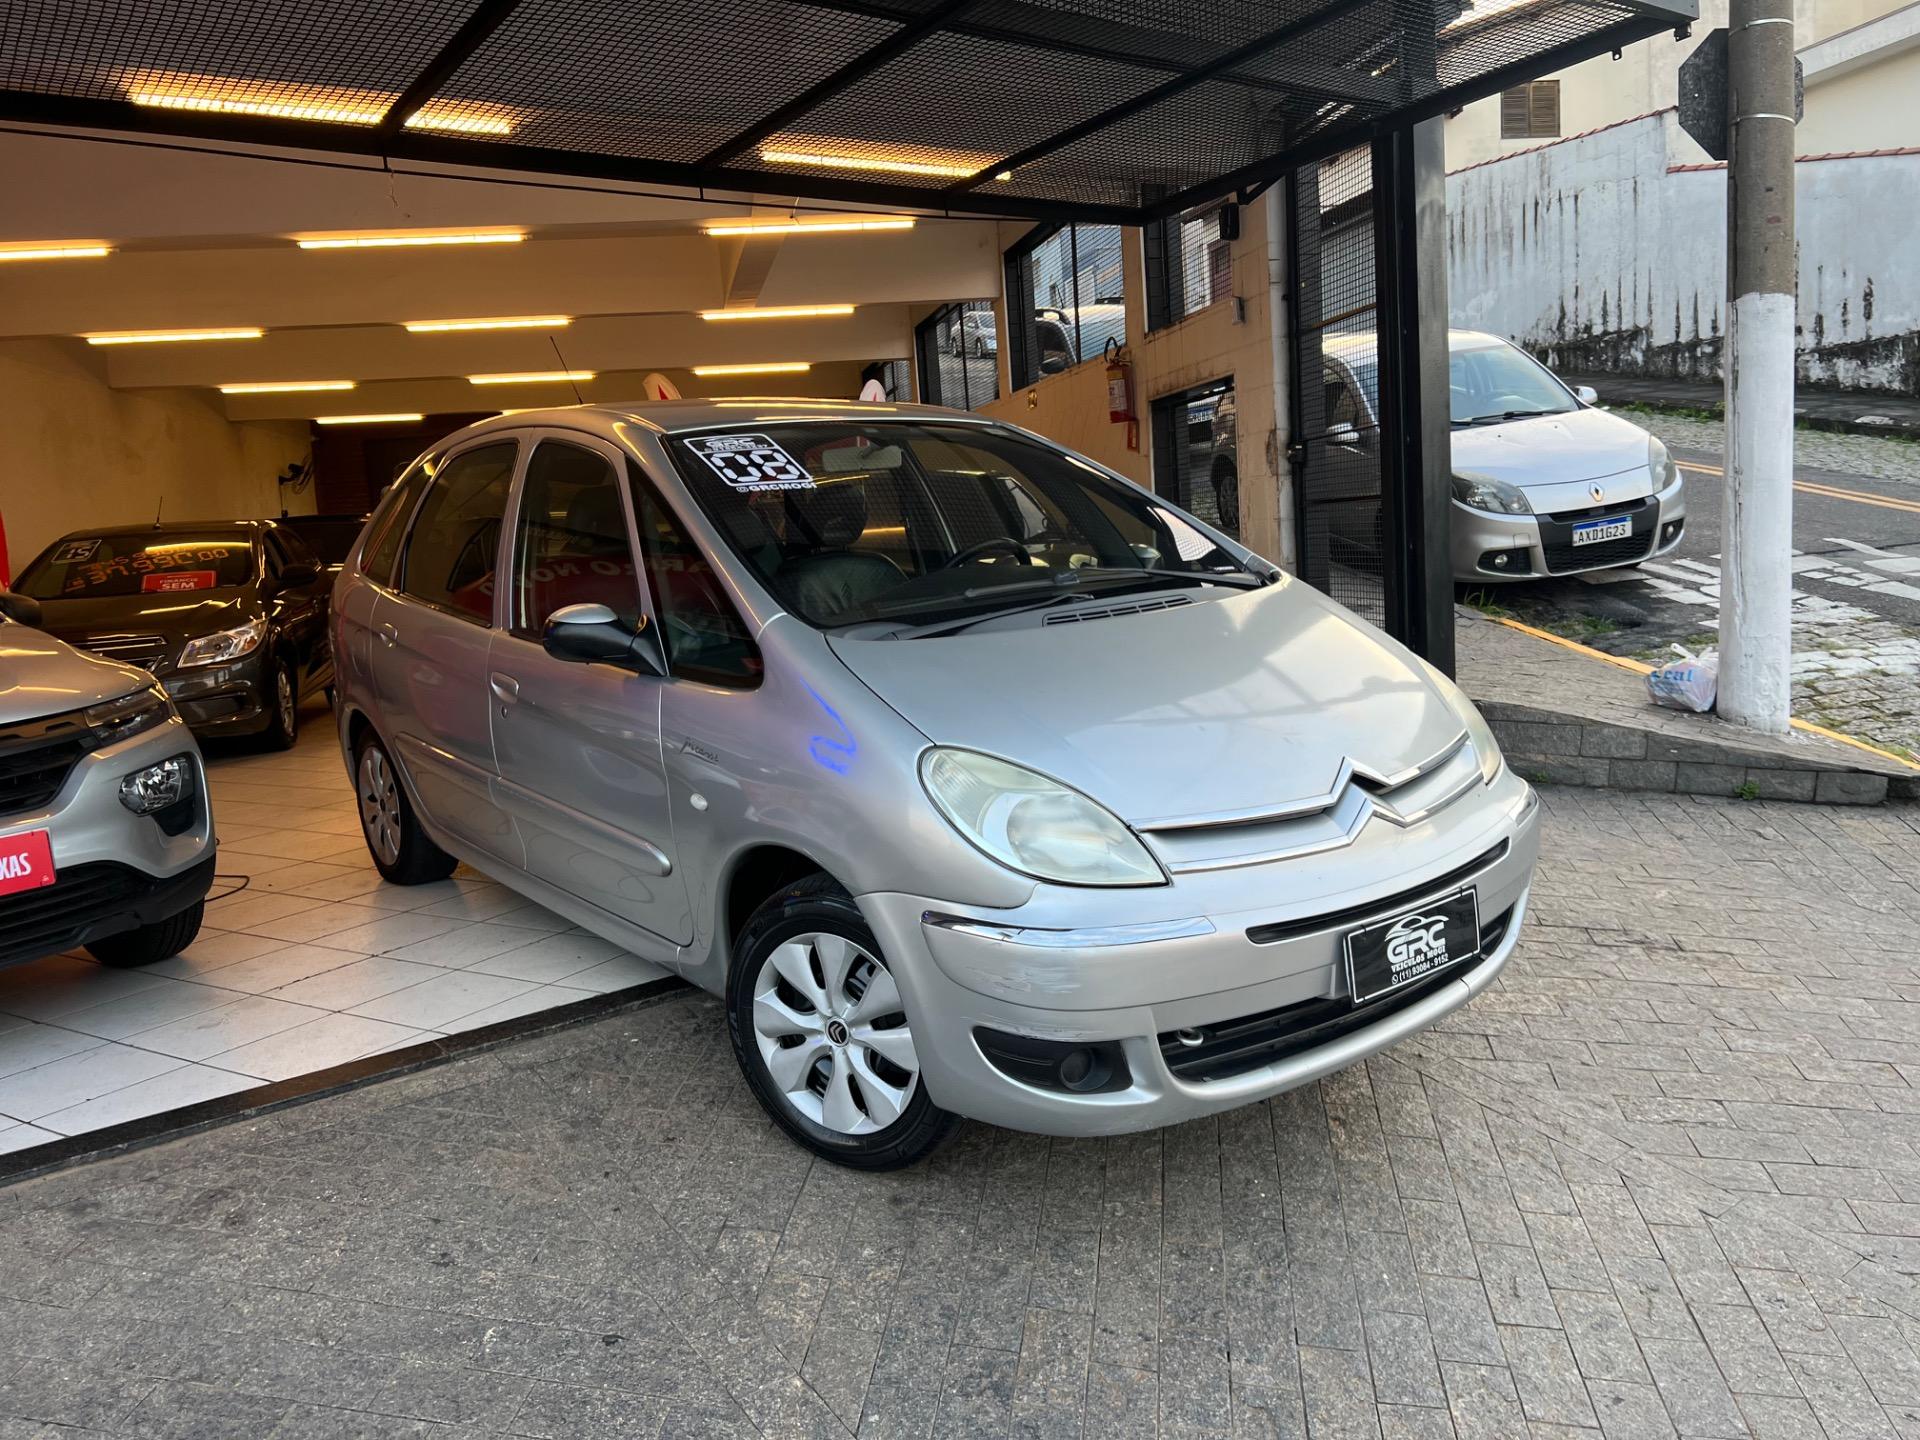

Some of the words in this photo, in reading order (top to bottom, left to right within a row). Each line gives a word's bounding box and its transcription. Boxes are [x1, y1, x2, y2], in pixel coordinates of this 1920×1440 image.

[711, 450, 800, 482] 08
[1578, 525, 1626, 544] AXD1G23
[161, 582, 195, 590] SEM
[1387, 922, 1446, 964] GRC
[1391, 953, 1425, 973] VEICULOS
[1426, 945, 1446, 959] MOGI
